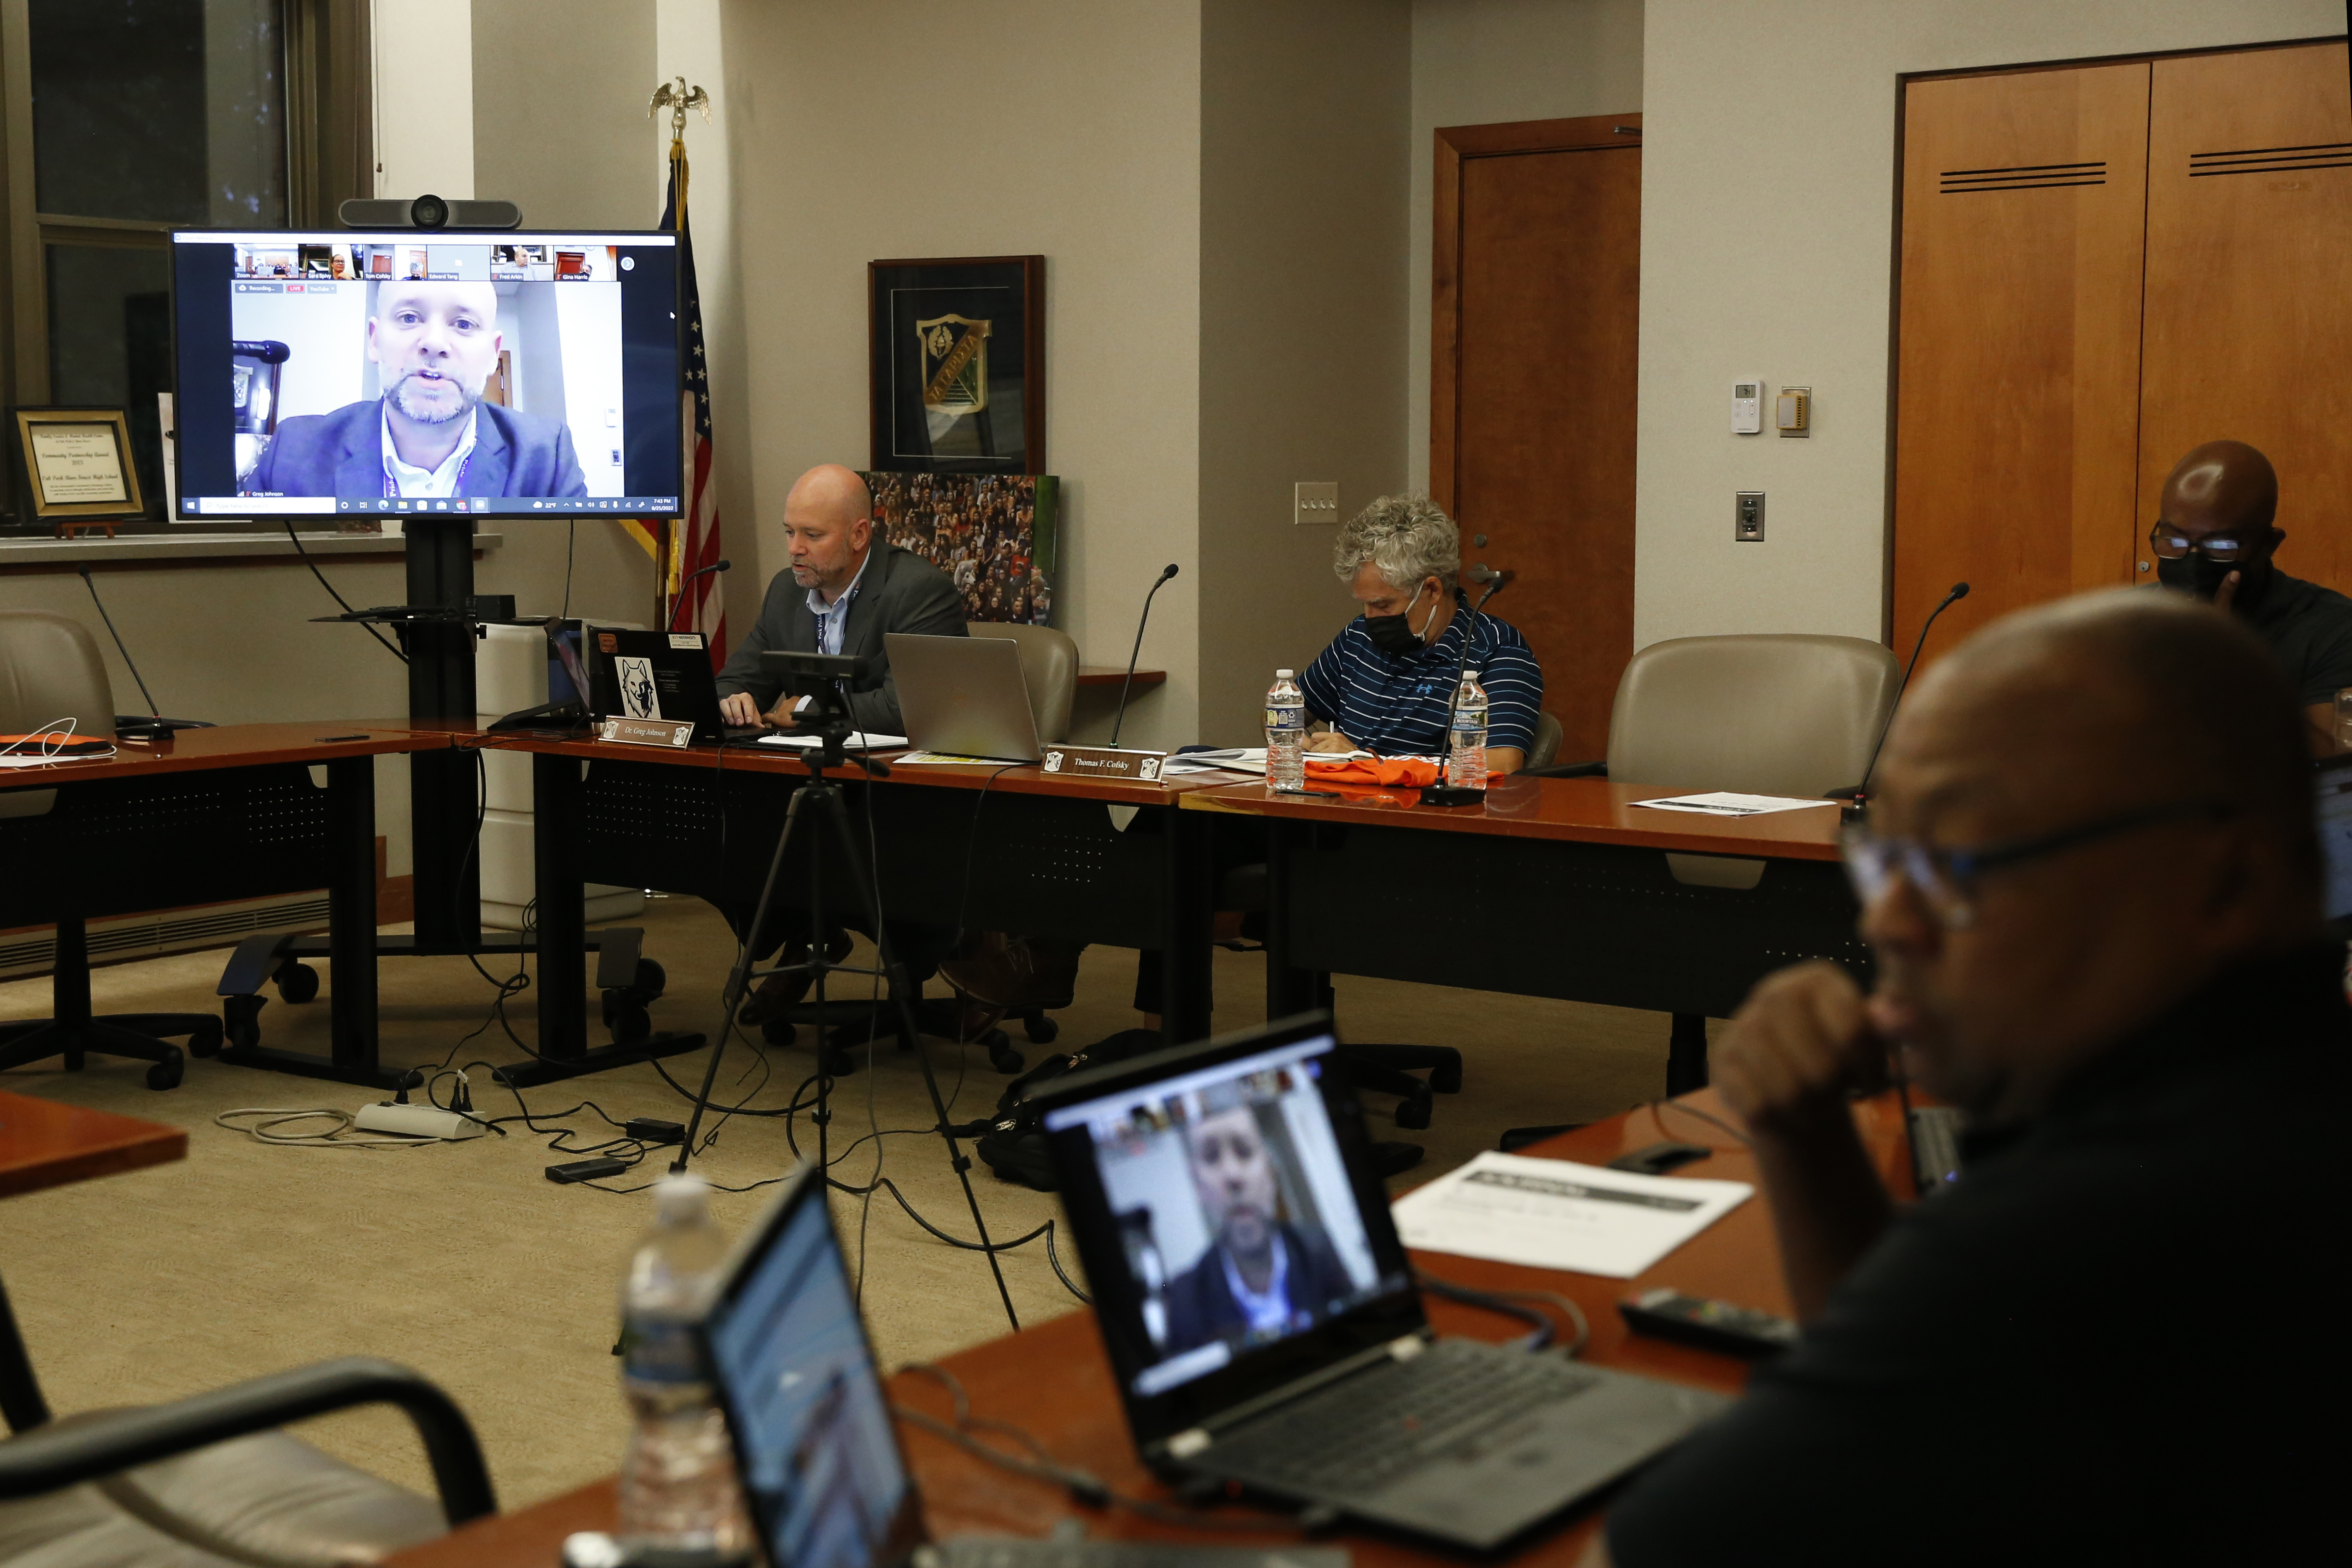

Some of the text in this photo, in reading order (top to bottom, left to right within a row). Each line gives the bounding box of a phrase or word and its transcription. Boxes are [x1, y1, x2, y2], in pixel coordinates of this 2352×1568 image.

[633, 727, 646, 736] Greg
[1075, 757, 1098, 767] Thomas
[1107, 760, 1130, 771] Cofsky
